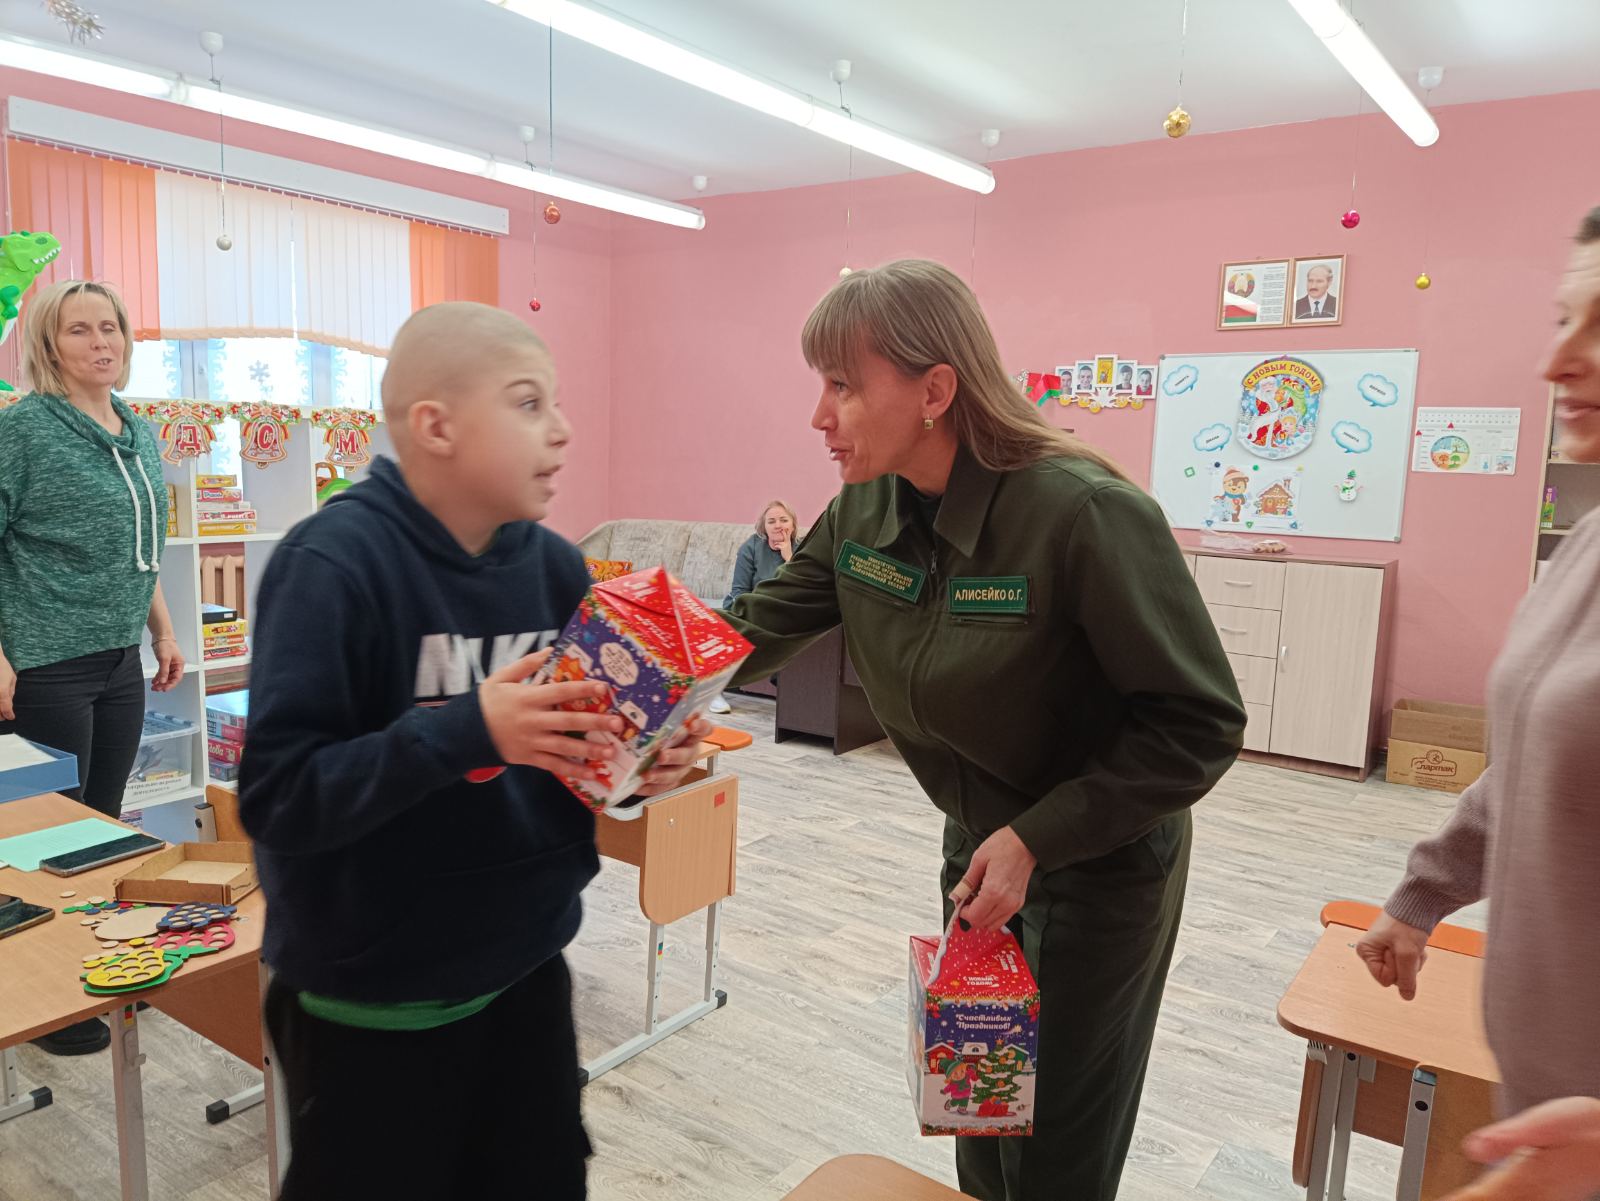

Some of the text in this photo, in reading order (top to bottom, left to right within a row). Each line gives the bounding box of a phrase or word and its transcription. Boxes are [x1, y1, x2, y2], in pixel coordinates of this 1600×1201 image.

[1252, 363, 1287, 381] НОВЫМ
[954, 586, 1023, 600] АЛИСЕЙКО О.Г.
[955, 1013, 1012, 1022] Счастливых
[956, 1021, 1011, 1030] Праздников!
